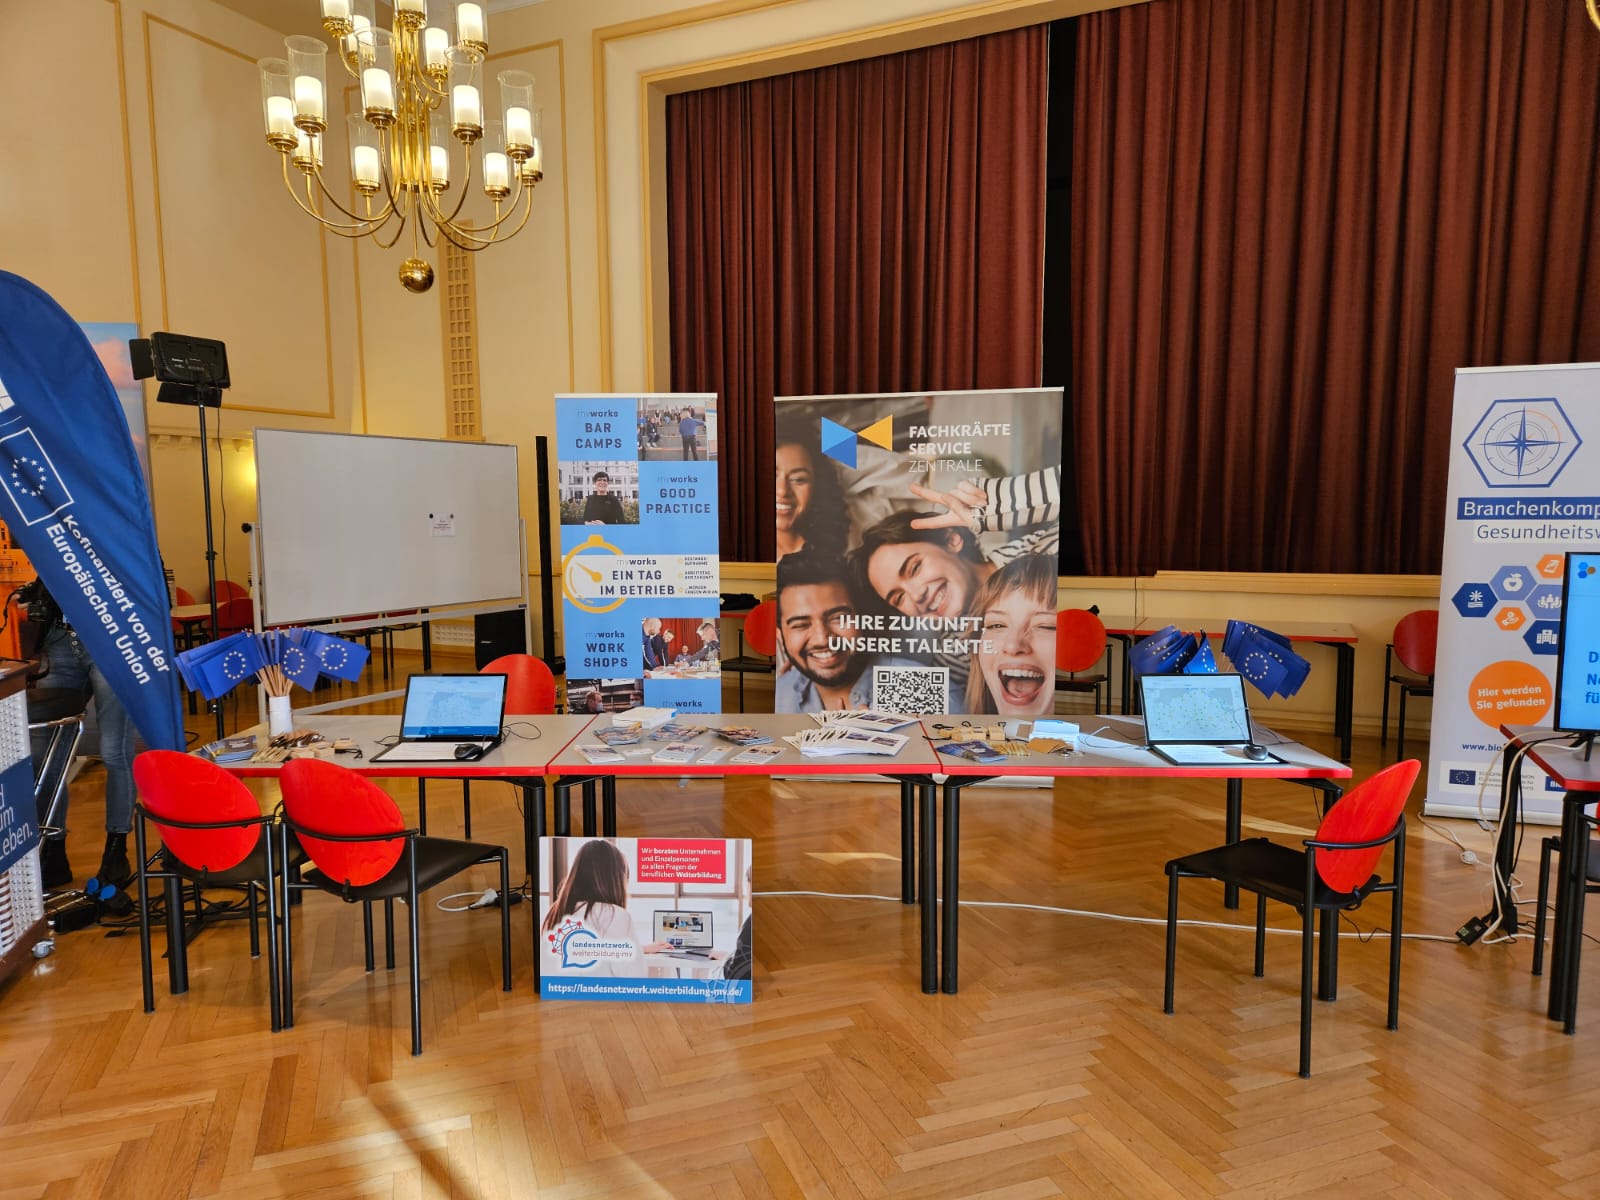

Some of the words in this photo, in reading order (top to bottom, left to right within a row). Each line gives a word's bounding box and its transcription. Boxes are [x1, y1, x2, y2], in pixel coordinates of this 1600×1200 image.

[585, 422, 612, 433] BAR
[908, 421, 1011, 438] FACHKRÄFTE
[575, 438, 622, 449] CAMPS
[908, 442, 972, 456] SERVICE
[908, 459, 983, 473] ZENTRALE
[659, 488, 696, 498] GOOD
[645, 503, 711, 514] PRACTICE
[1463, 500, 1600, 519] Branchenkomp
[612, 570, 634, 580] EIN
[638, 570, 662, 580] TAG
[63, 514, 135, 612] Kofinanziert
[128, 612, 152, 644] von
[147, 641, 170, 674] der
[600, 585, 615, 595] IM
[620, 585, 675, 595] BETRIEB
[46, 522, 121, 637] Europäischen
[116, 634, 151, 685] Union
[839, 614, 885, 631] IHRE
[889, 615, 986, 634] ZUKUNFT,
[586, 642, 625, 653] WORK
[828, 636, 902, 653] UNSERE
[906, 638, 998, 654] TALENTE.
[583, 657, 628, 668] SHOPS
[1477, 687, 1499, 697] Hier
[1502, 686, 1542, 696] werden
[1476, 700, 1492, 710] Sie
[1496, 697, 1546, 711] gefunden
[641, 847, 653, 855] Wir
[653, 847, 679, 855] beraten
[679, 848, 721, 856] Unternehmen
[654, 855, 700, 864] Einzelpersonen
[665, 863, 687, 872] Fragen
[641, 870, 675, 878] beruflichen
[675, 871, 722, 880] Weiterbildung
